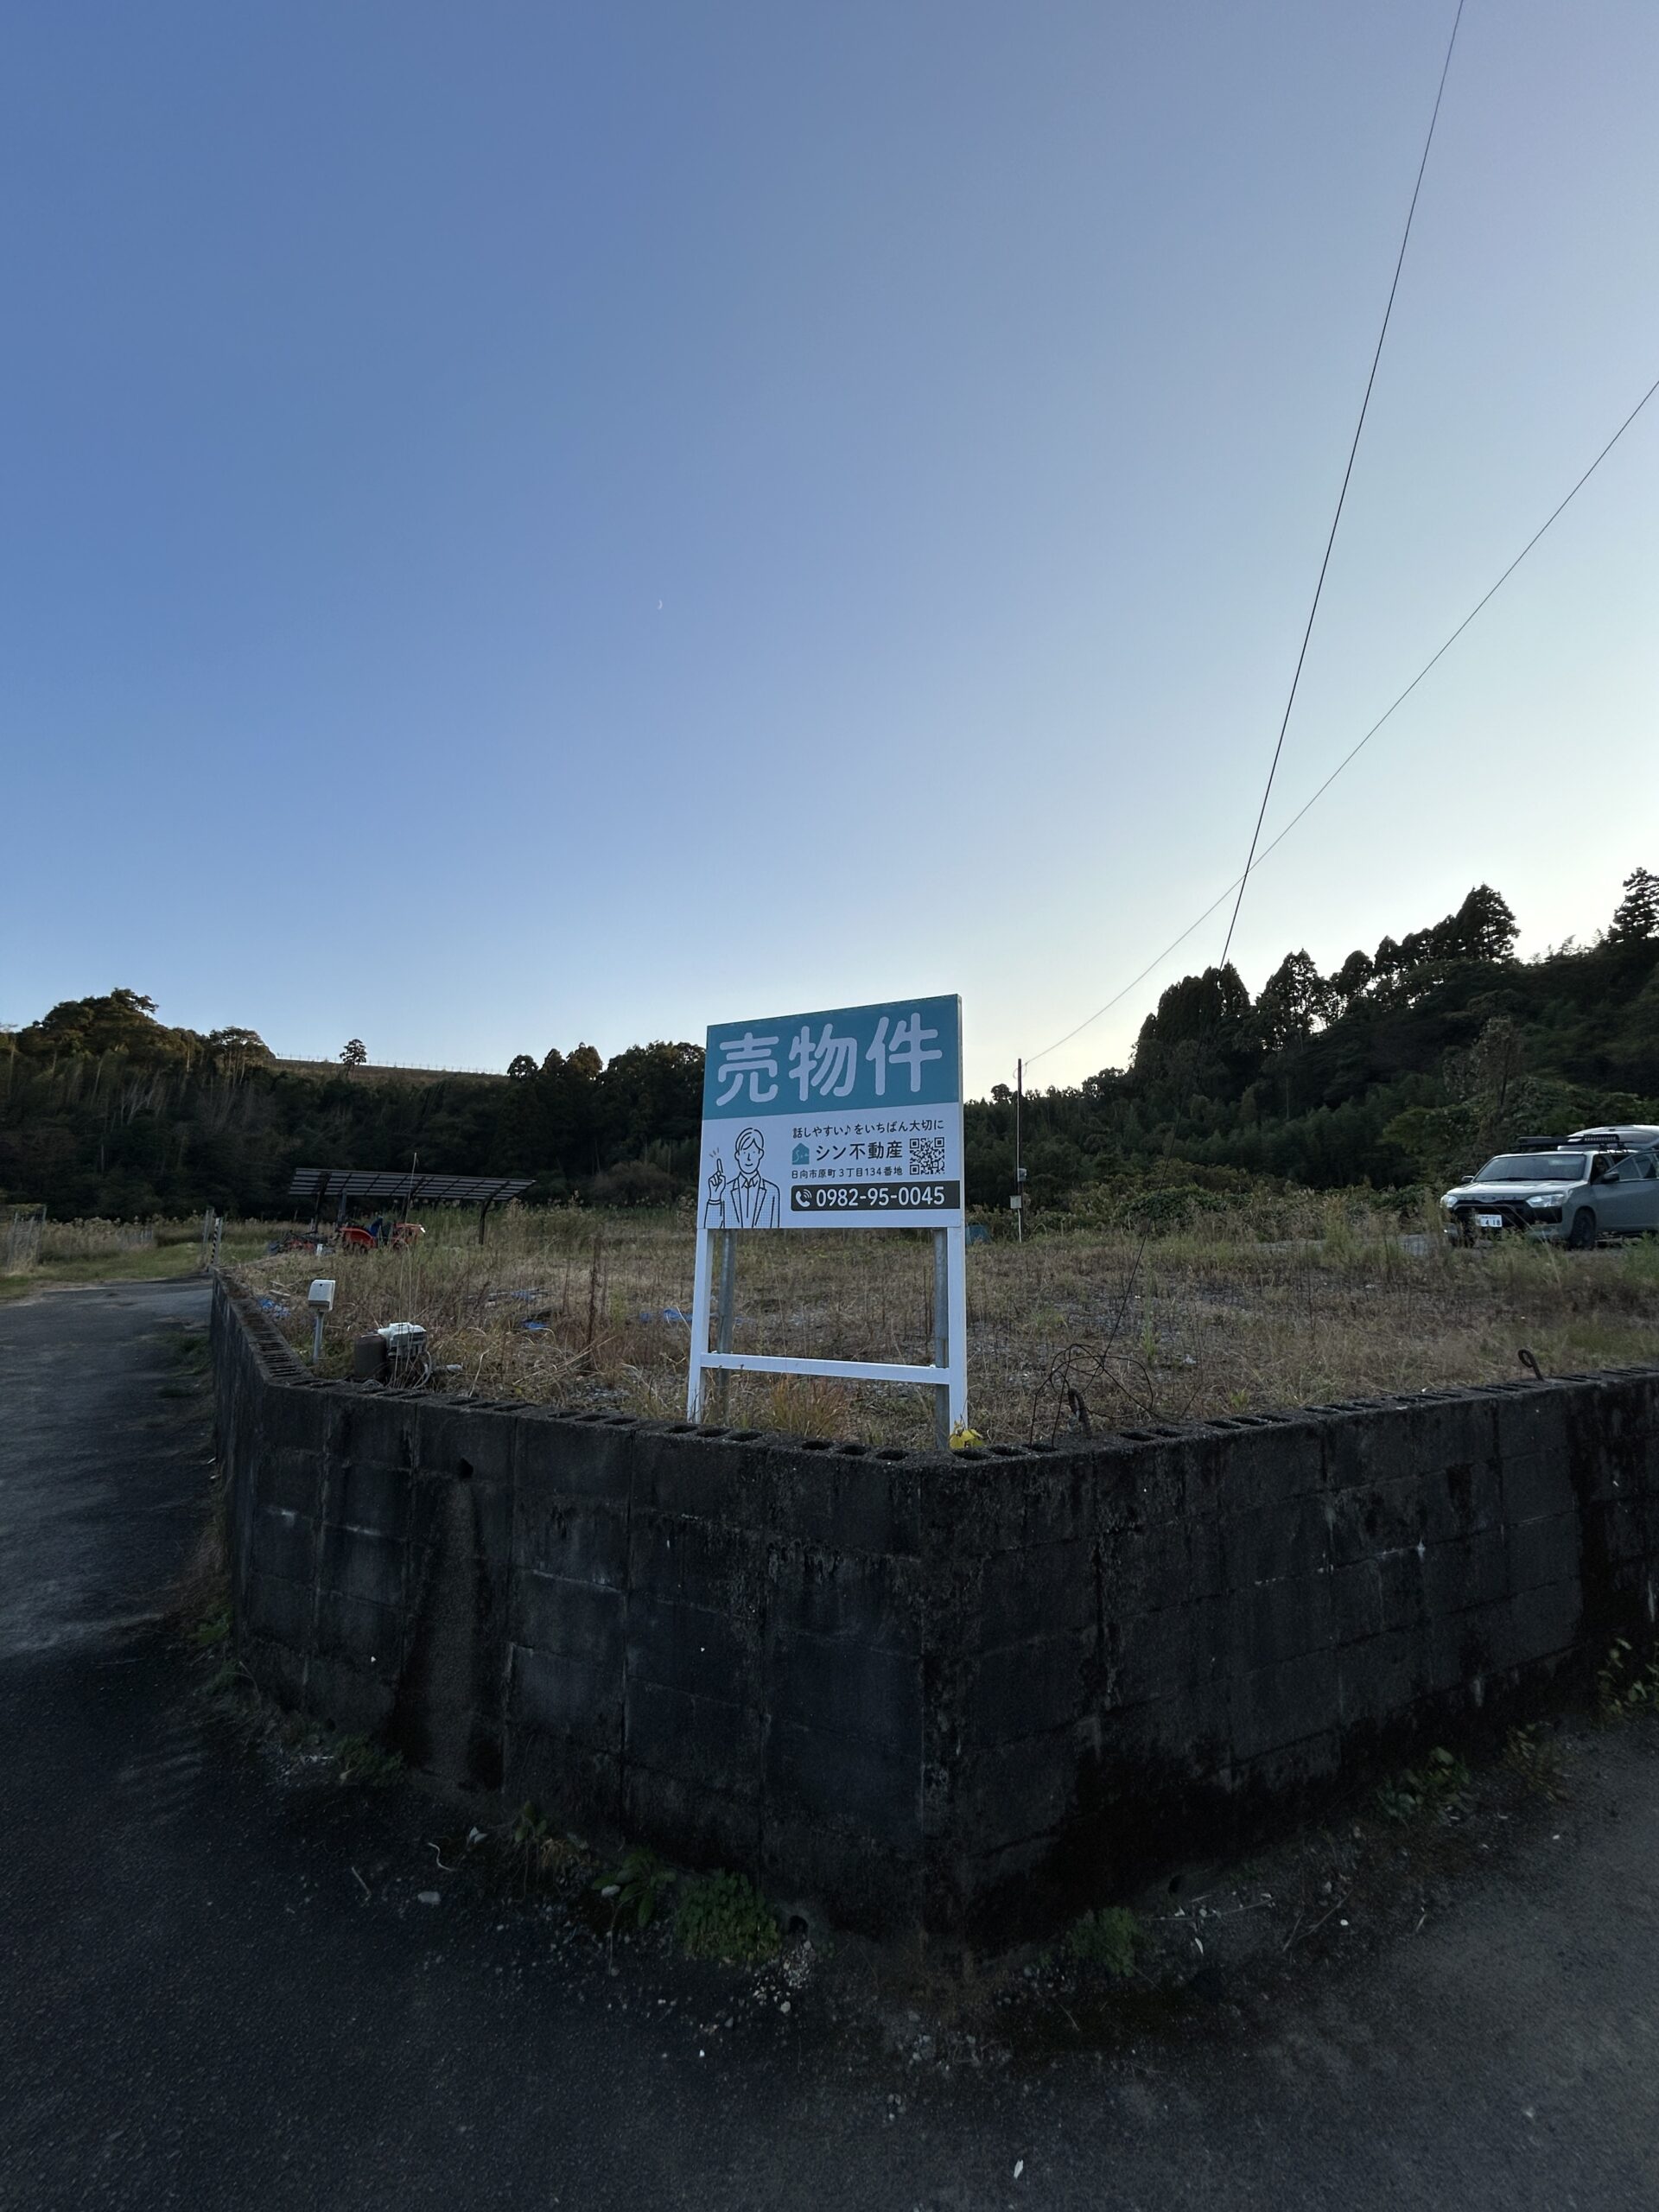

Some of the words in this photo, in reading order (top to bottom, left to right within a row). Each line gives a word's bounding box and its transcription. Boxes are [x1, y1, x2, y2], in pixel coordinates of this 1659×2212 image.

[715, 1012, 943, 1107] 売物件
[816, 1141, 903, 1161] シン不動産
[791, 1166, 903, 1179] 日向市原町3丁目134番地
[816, 1185, 945, 1207] 0982-95-0045
